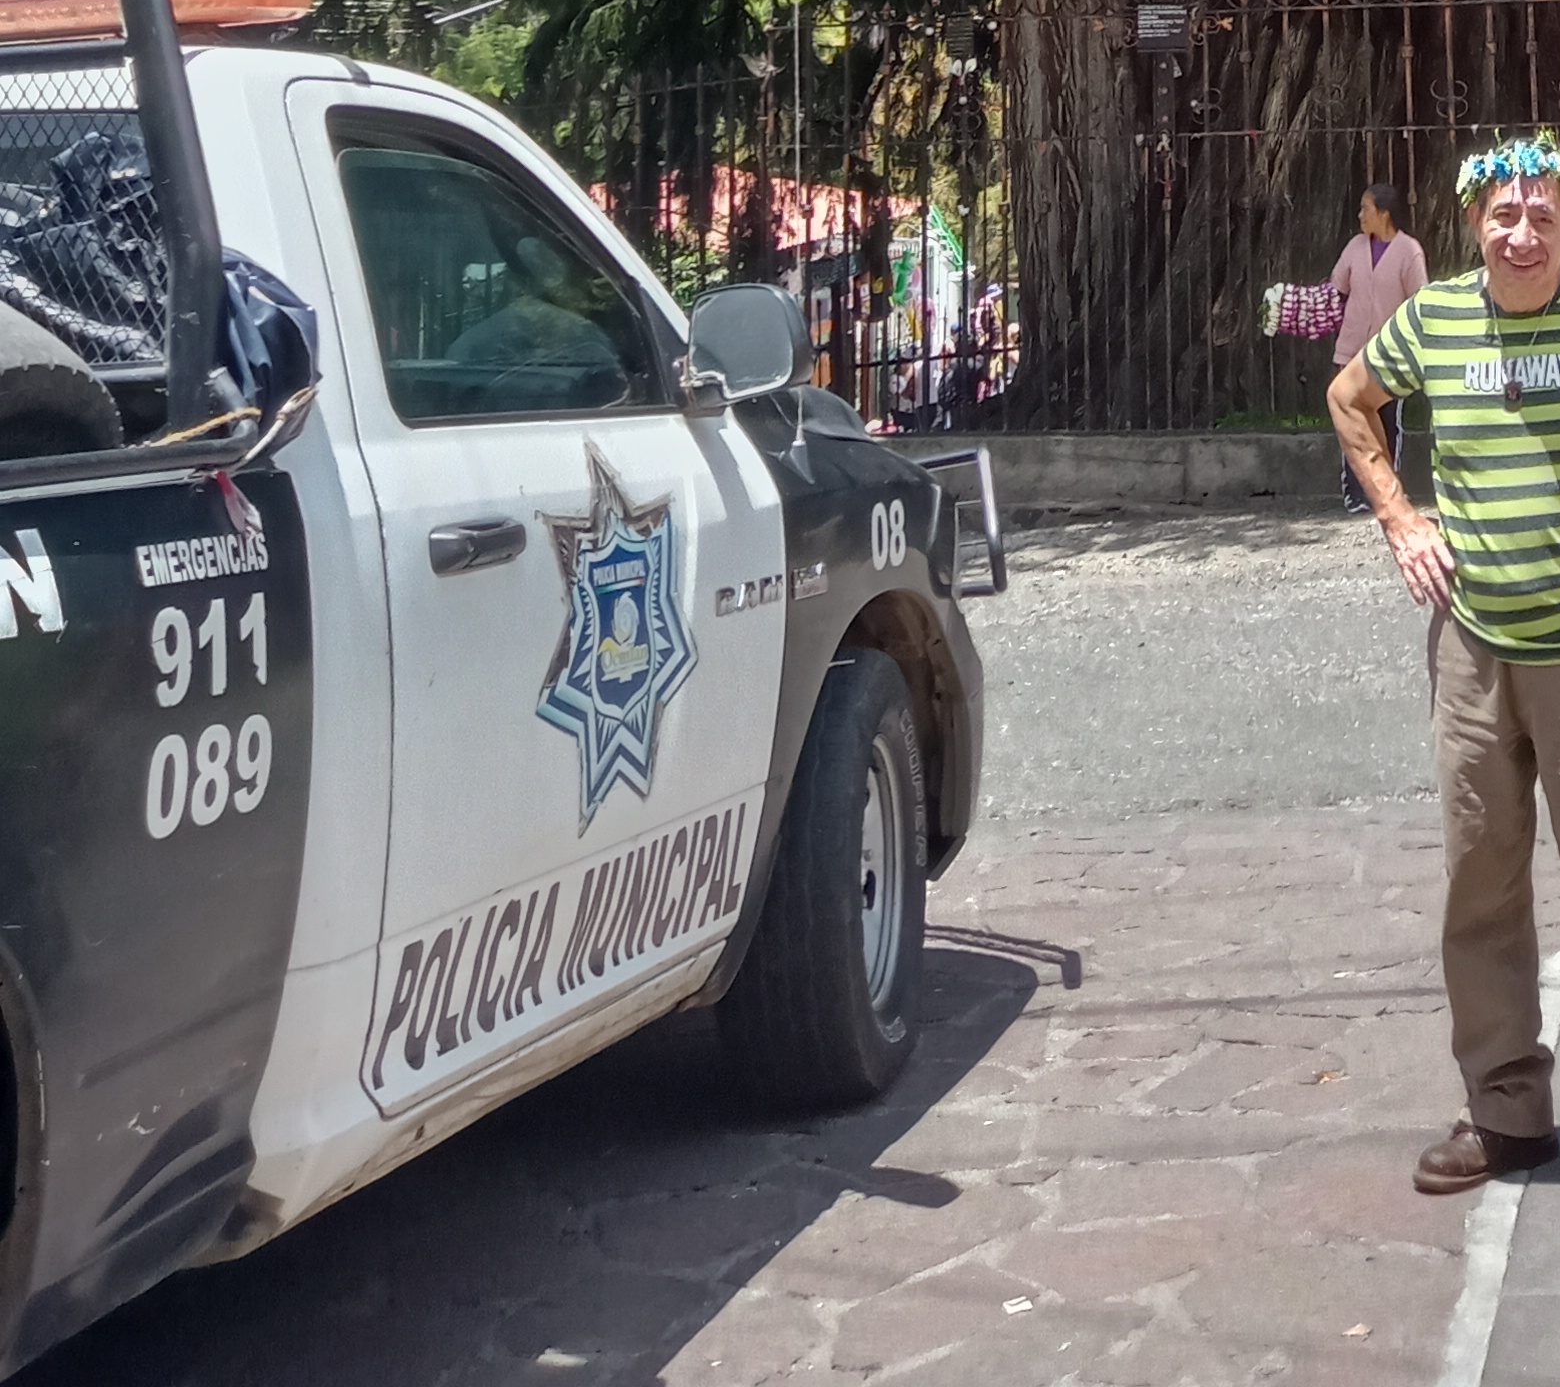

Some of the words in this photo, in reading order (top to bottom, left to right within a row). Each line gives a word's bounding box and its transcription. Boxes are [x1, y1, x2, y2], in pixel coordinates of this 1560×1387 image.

[135, 532, 269, 588] EMERGENCIAS
[871, 498, 906, 571] 08
[716, 574, 783, 617] RAM
[151, 591, 268, 707] 911
[147, 714, 273, 839] 089
[371, 881, 560, 1091] POLICIA
[557, 802, 747, 995] MUNICIPAL
